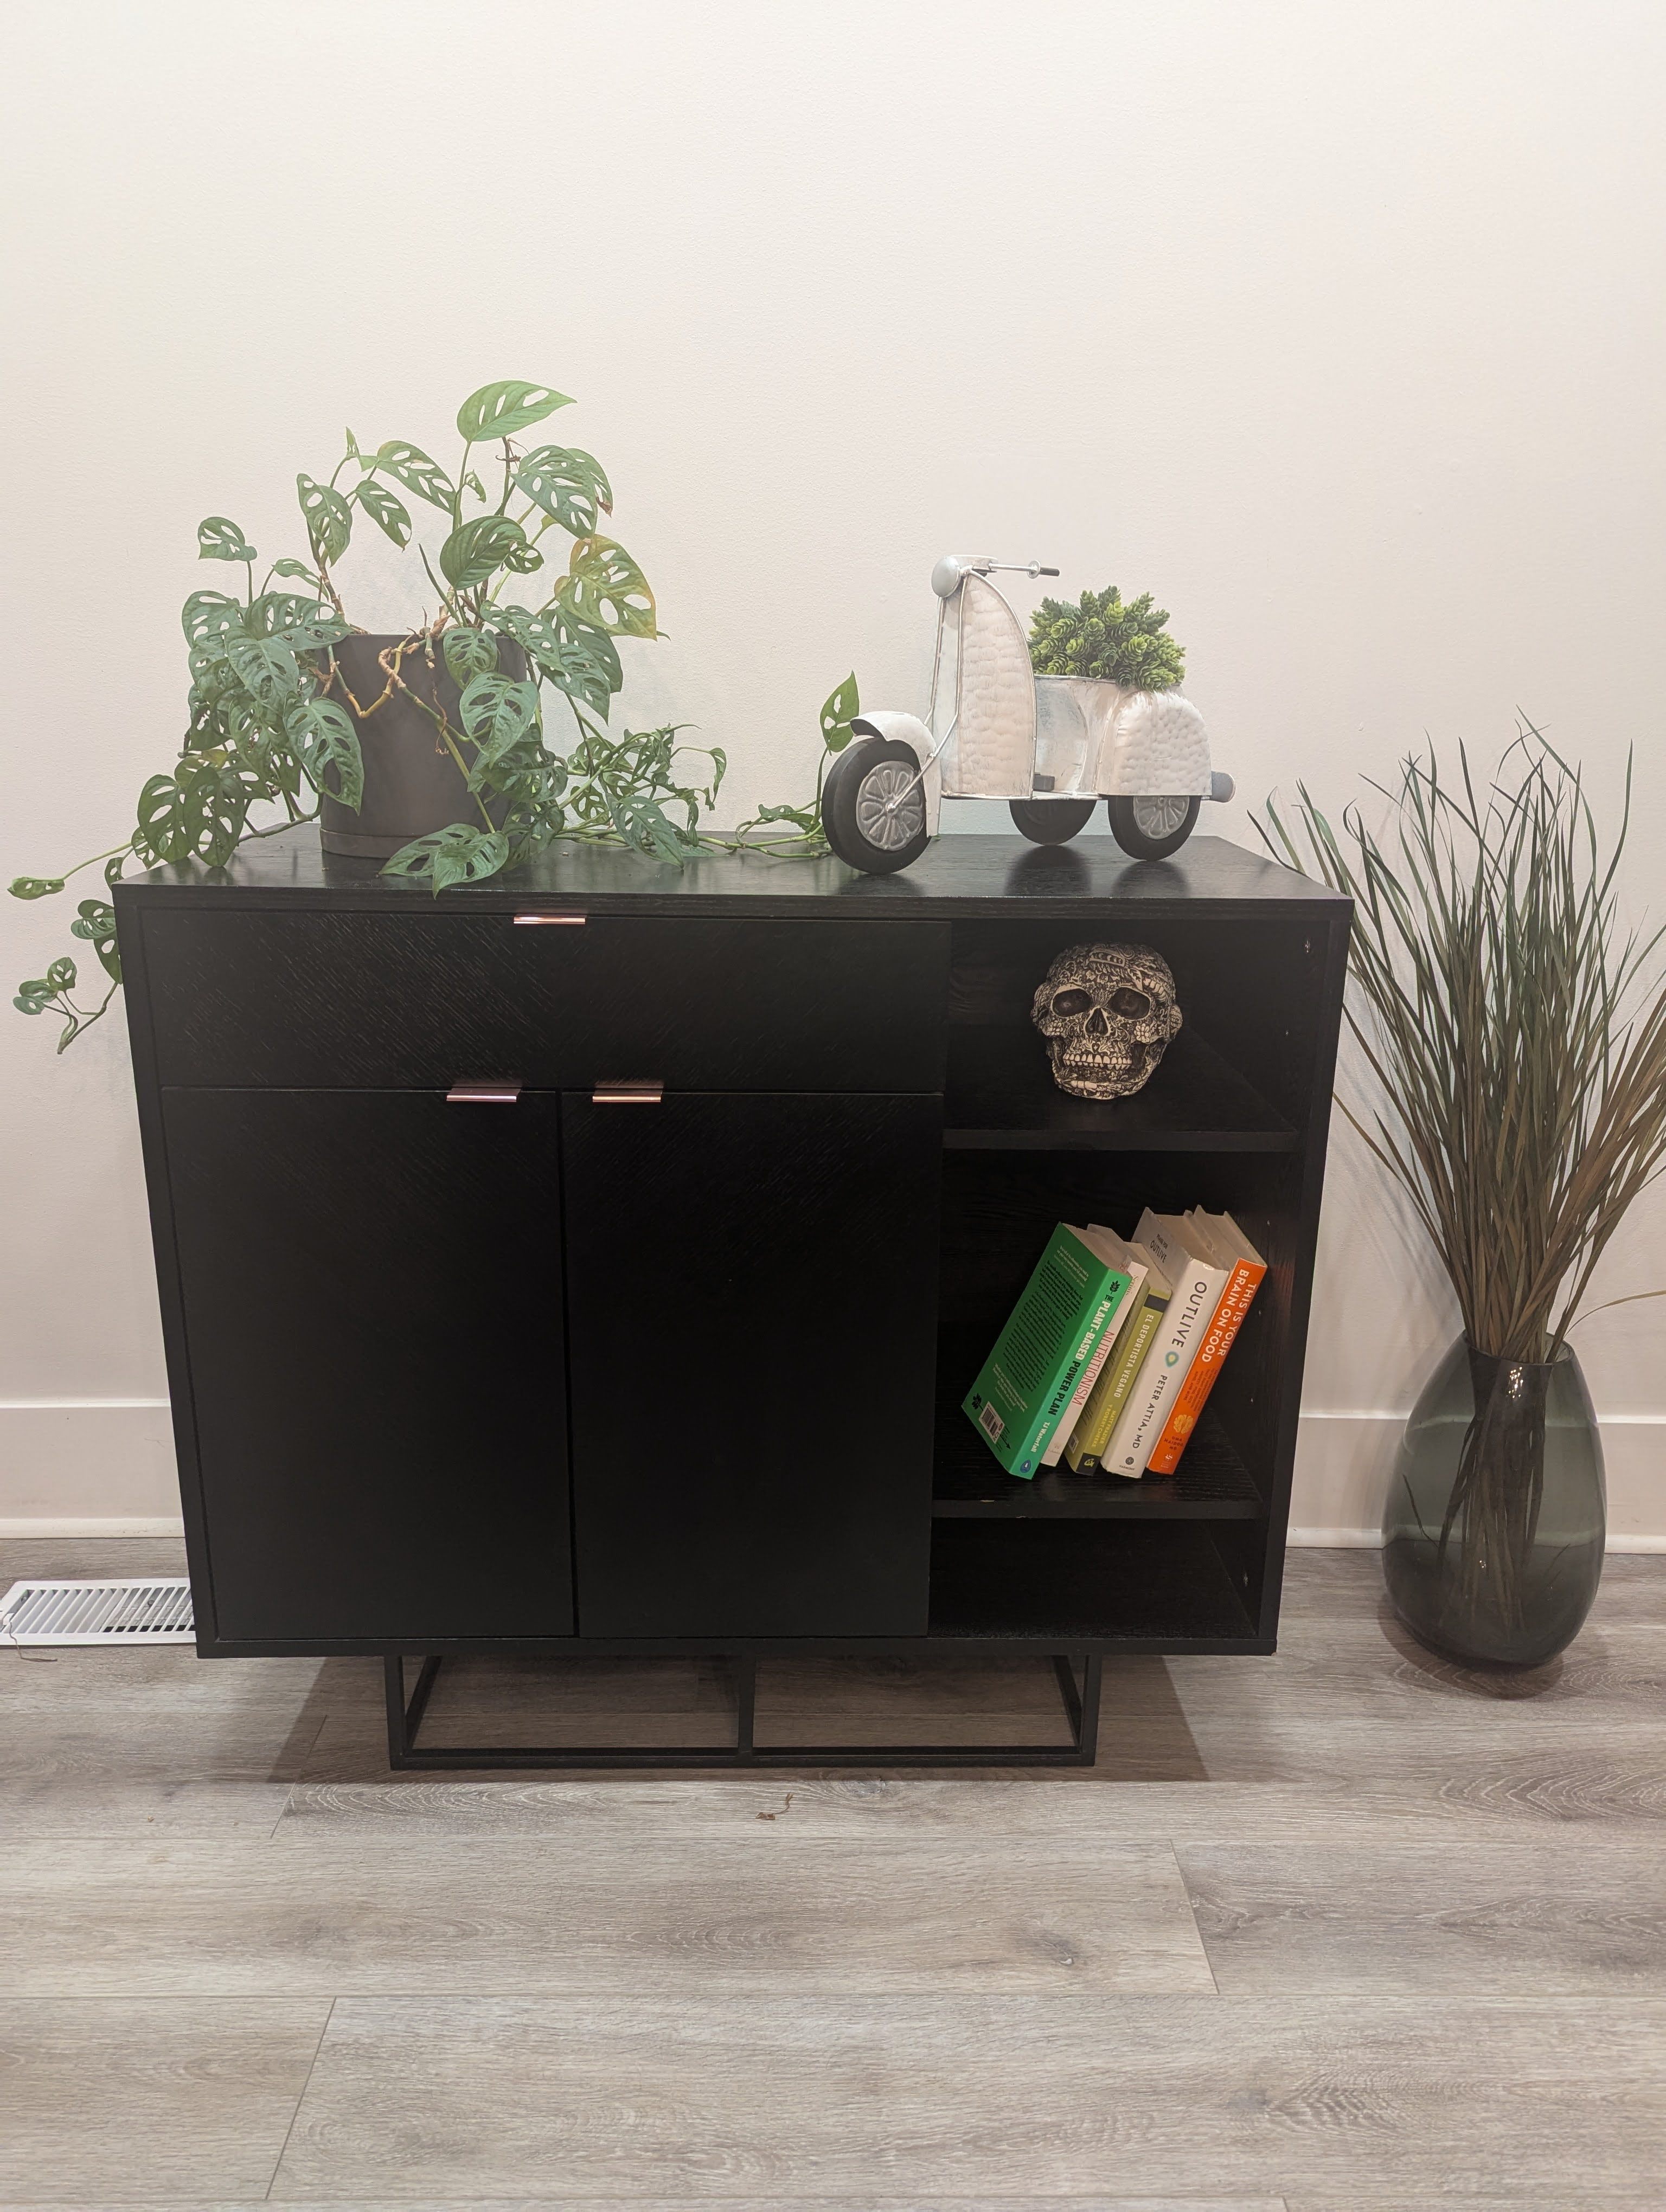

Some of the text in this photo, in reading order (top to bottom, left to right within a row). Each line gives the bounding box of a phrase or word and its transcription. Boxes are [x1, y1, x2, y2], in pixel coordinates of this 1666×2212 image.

[1150, 1240, 1167, 1263] OUTLIVE
[1171, 1282, 1207, 1348] OUTLIVE
[1216, 1308, 1232, 1327] ON
[1217, 1283, 1257, 1356] THIS IS YOUR
[1226, 1269, 1250, 1307] BRAIN
[1048, 1294, 1114, 1416] THE PLANT-BASED POWER PLAN
[1072, 1331, 1114, 1405] NUTRITIONISM
[1113, 1314, 1154, 1398] EL DEPORTISTA VEGANO
[1202, 1329, 1223, 1362] FOOD
[1031, 1428, 1047, 1452] Waterfall
[1132, 1374, 1168, 1449] PETER ATTIA, MD
